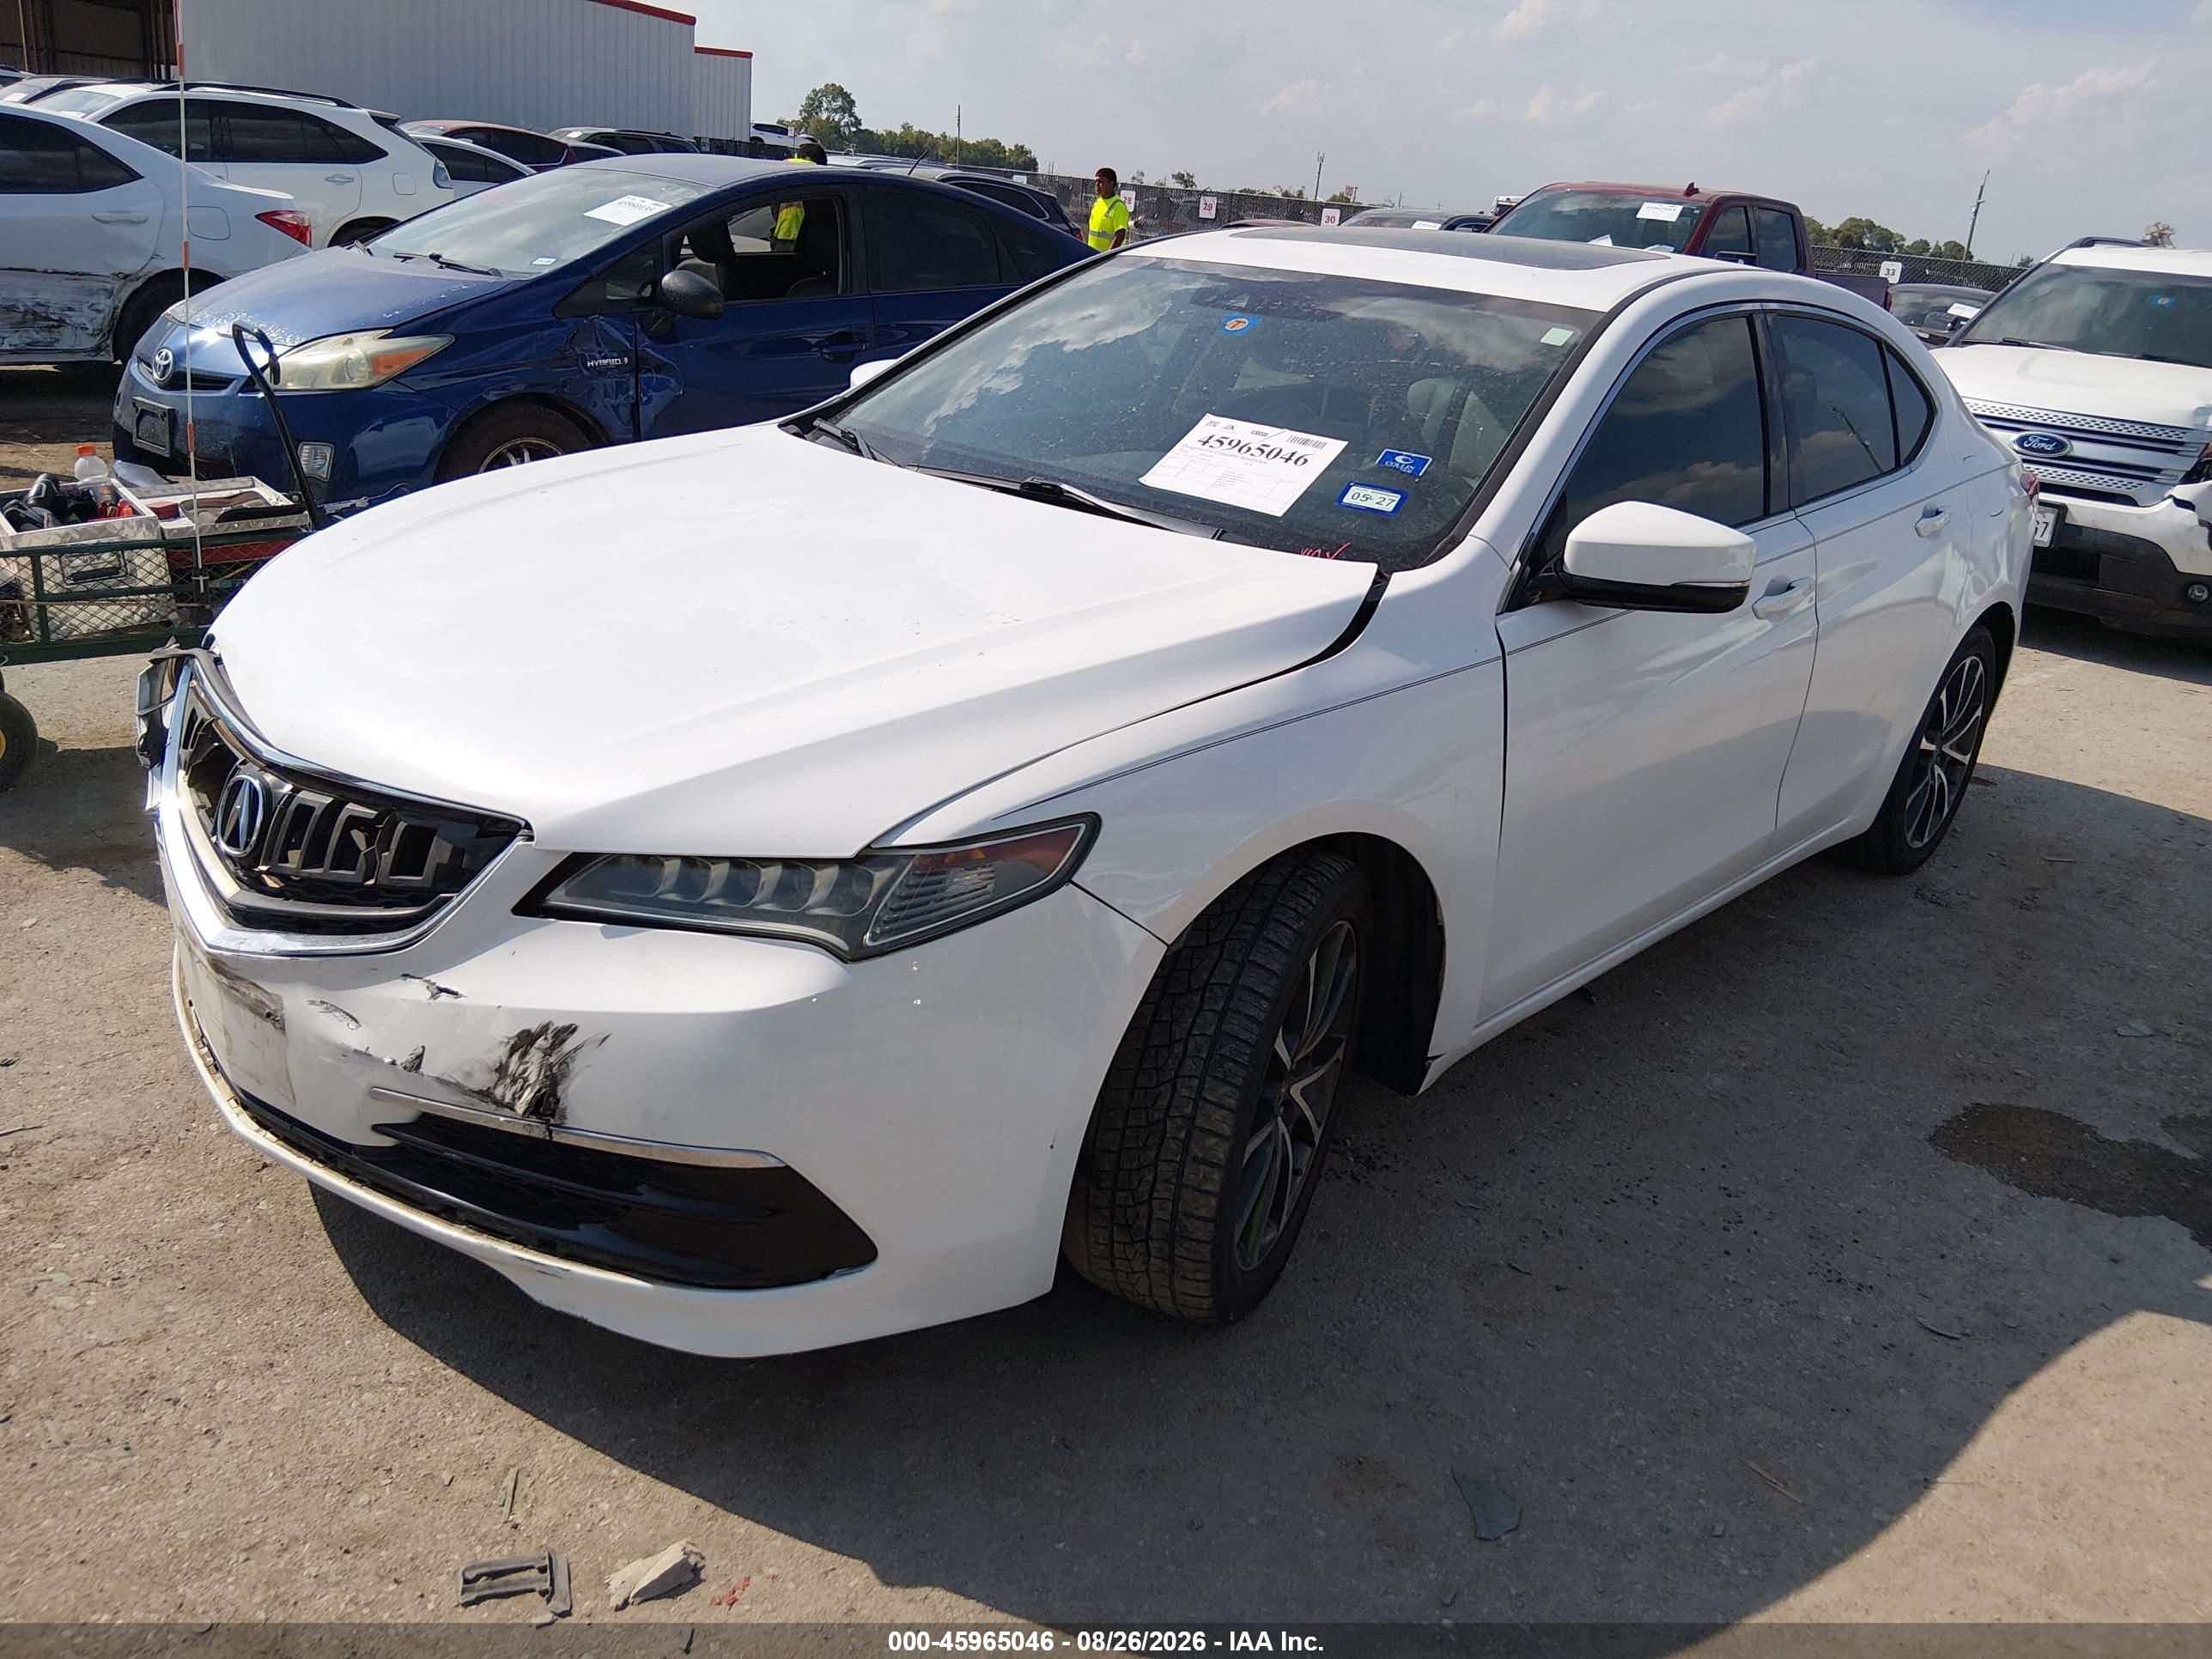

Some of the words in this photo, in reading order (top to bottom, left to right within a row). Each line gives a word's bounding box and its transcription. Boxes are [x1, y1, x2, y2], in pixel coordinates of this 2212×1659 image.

[1202, 203, 1213, 211] 29
[1324, 216, 1336, 224] 30
[1884, 268, 1896, 276] 33
[586, 358, 623, 368] HYBRID
[2023, 435, 2057, 451] Ford
[1198, 434, 1313, 467] 45965046
[1351, 492, 1370, 502] 05
[1375, 497, 1396, 507] 27
